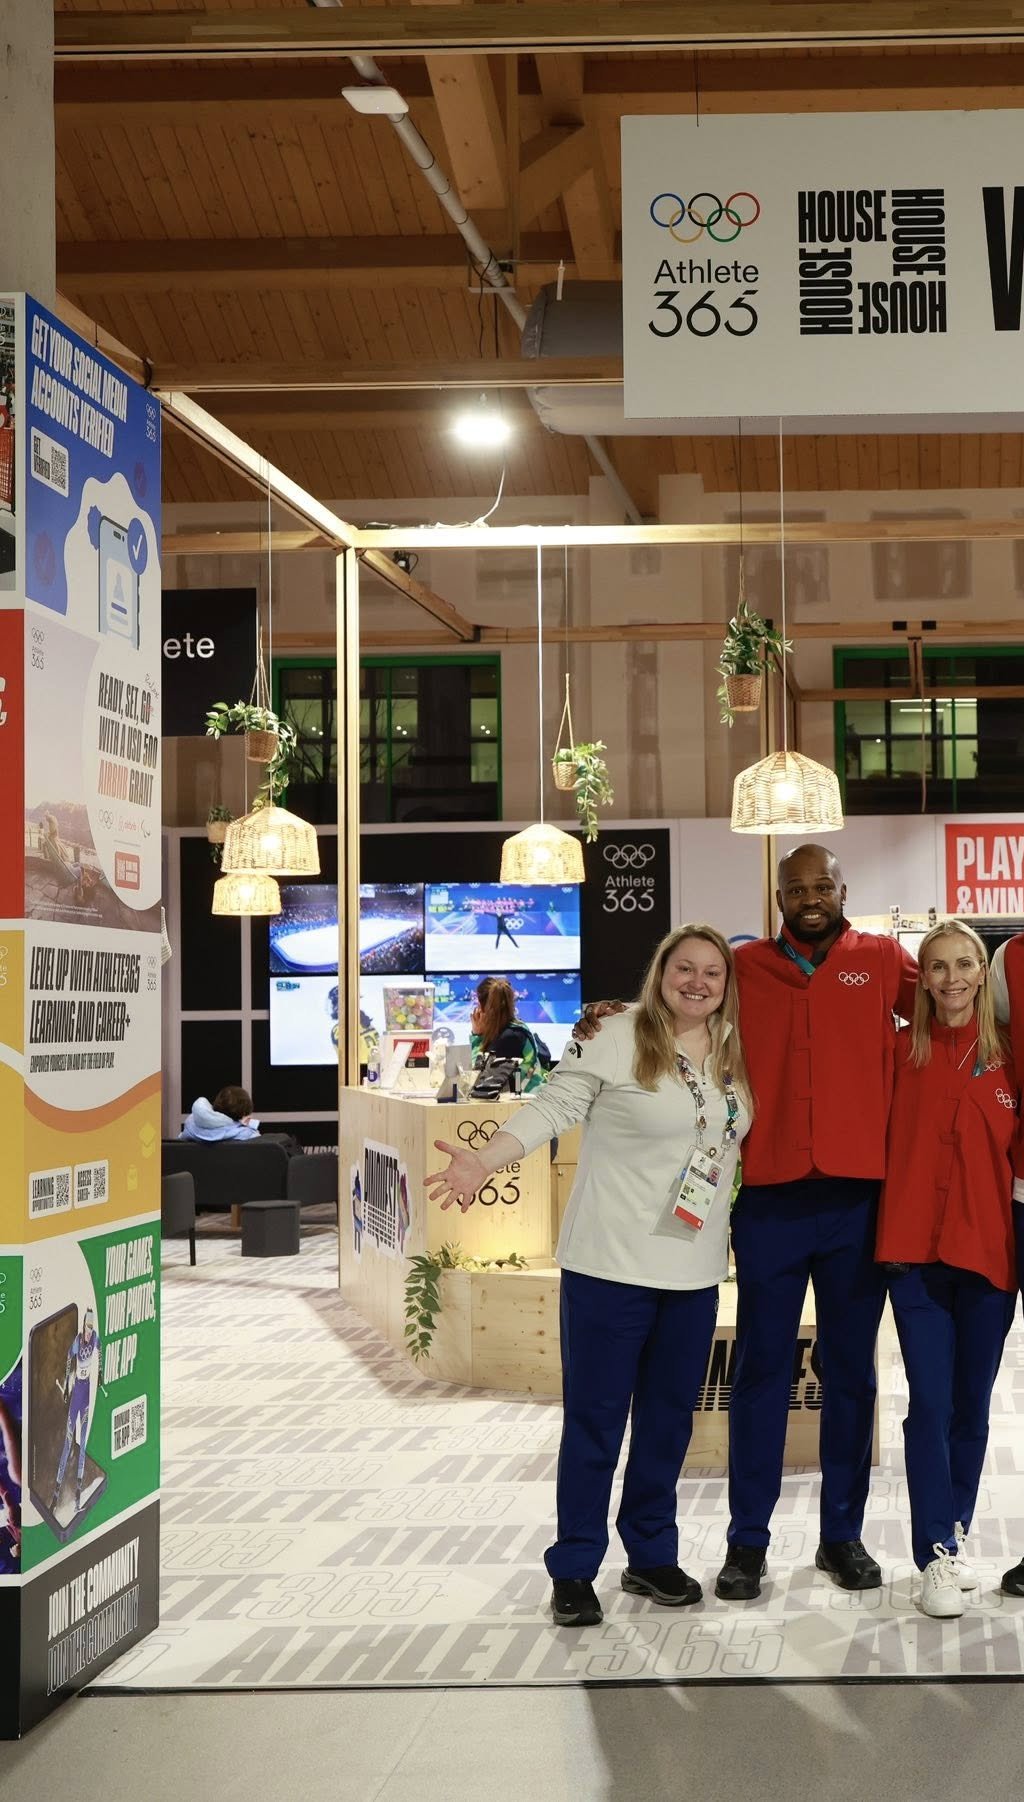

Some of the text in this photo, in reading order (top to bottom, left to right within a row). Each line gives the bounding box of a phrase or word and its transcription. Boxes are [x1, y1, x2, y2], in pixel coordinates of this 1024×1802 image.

[798, 189, 889, 243] HOUSE
[891, 188, 948, 277] HOUSE
[654, 259, 760, 285] Athlete
[798, 247, 855, 336] HOUSE
[648, 290, 760, 338] 365
[857, 280, 948, 335] HOUSE
[32, 313, 128, 424] GET YOUR SOCIAL MEDIA
[31, 365, 115, 459] ACCOUNTS VERIFIED
[32, 653, 45, 670] 365
[98, 672, 152, 725] READY, SET, GO
[99, 715, 159, 770] WITH A USD 500
[98, 758, 154, 808] AIRBNB GRANT
[602, 889, 657, 913] 365
[605, 873, 656, 888] Athlete
[956, 885, 1024, 913] & WIN
[30, 945, 56, 991] LEVEL
[55, 947, 70, 991] UP
[69, 949, 95, 992] WITH
[93, 951, 141, 993] ATHLETE365
[30, 999, 131, 1043] LEARNING AND CAREER+
[105, 1235, 153, 1288] YOUR GAMES,
[105, 1280, 156, 1337] YOUR PHOTOS,
[104, 1333, 138, 1385] ONE APP
[47, 1583, 70, 1642] JOIN
[69, 1571, 87, 1626] THE
[86, 1535, 140, 1613] COMMUNITY
[47, 1583, 141, 1697] JOIN THE COMMUNITY
[192, 1617, 787, 1684] ATHLETE365
